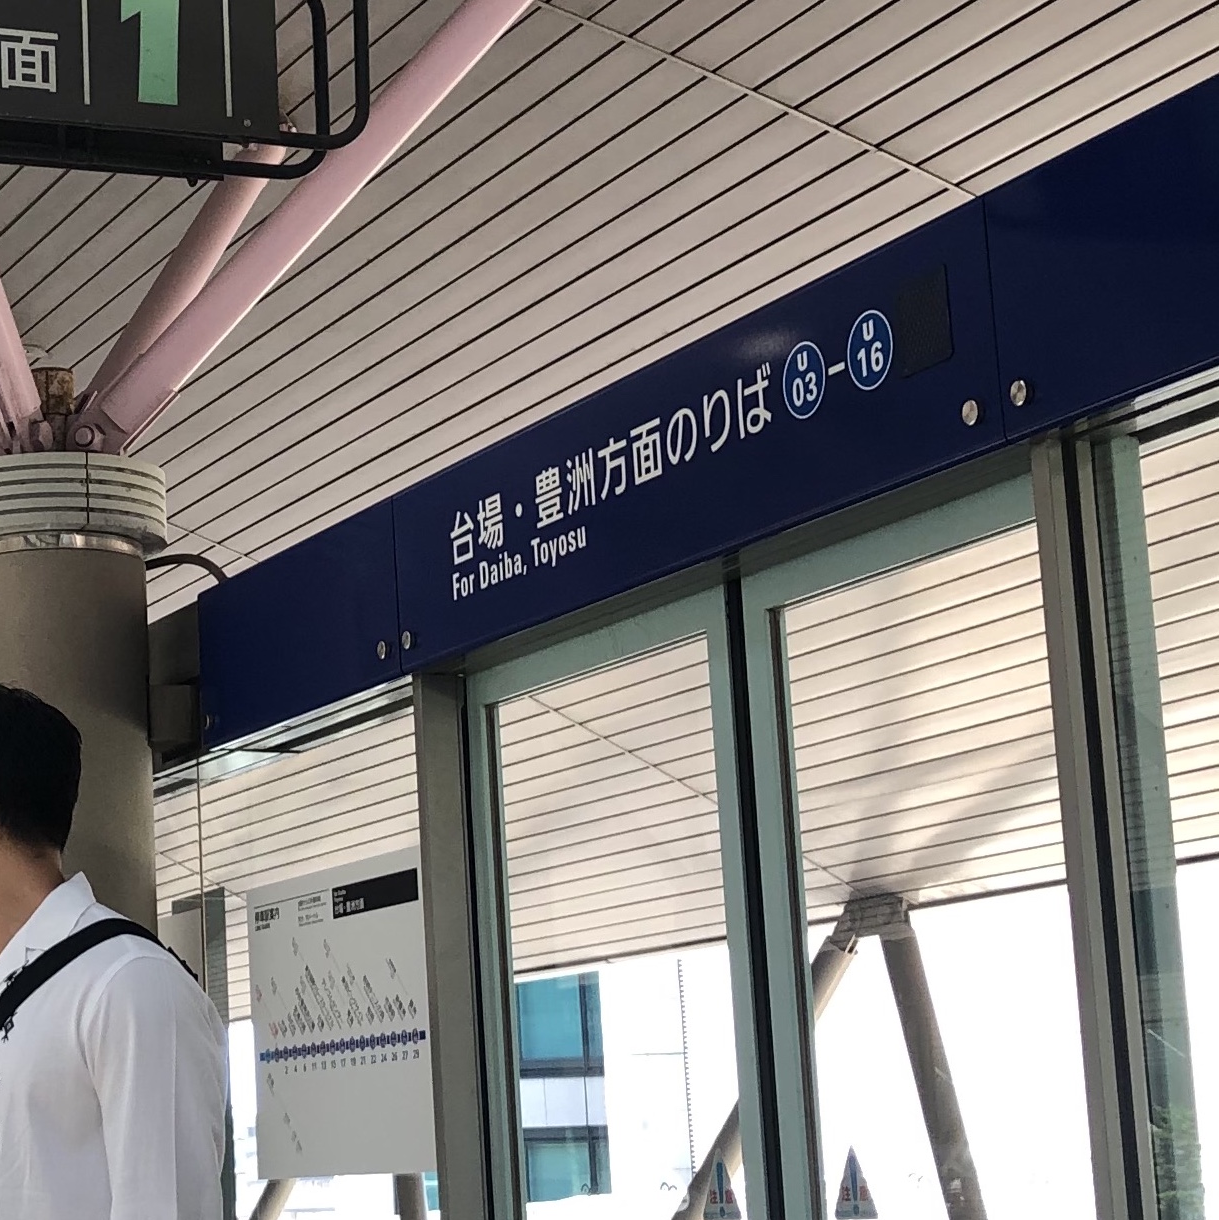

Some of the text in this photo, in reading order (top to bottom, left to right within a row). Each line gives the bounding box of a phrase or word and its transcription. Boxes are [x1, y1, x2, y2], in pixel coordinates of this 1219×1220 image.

[120, 0, 180, 105] 1
[862, 319, 874, 341] U
[796, 350, 808, 371] U
[857, 341, 884, 377] 16
[792, 371, 818, 407] 03
[449, 362, 773, 566] 台場・豊洲方面のりば
[452, 526, 587, 601] For Daiba, Toyosu
